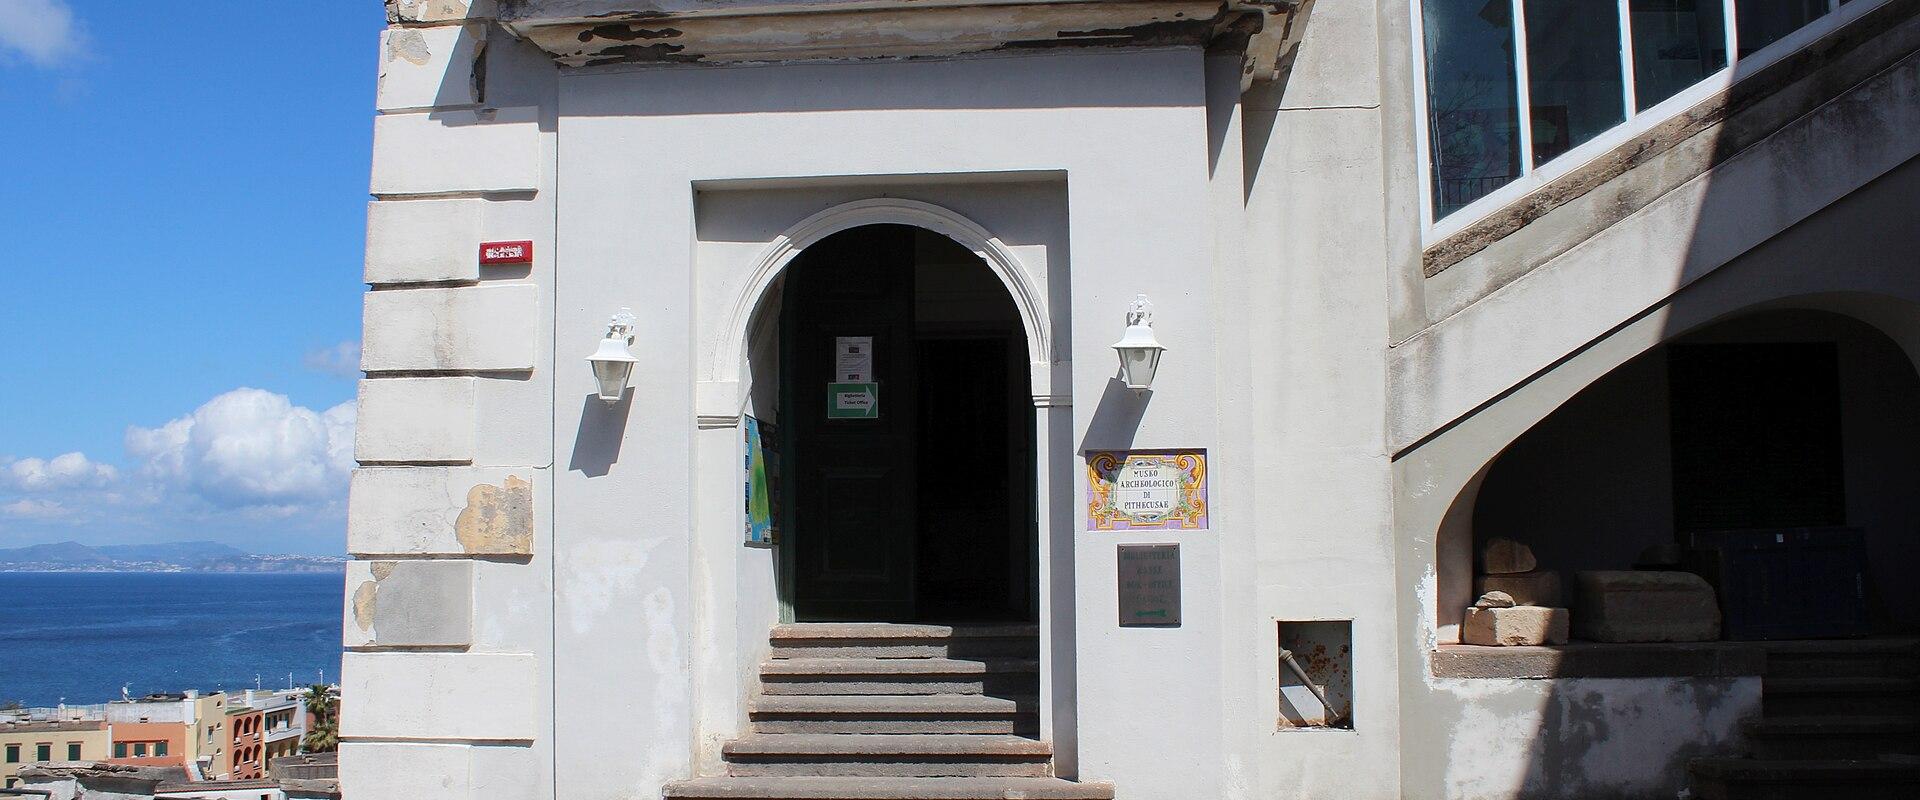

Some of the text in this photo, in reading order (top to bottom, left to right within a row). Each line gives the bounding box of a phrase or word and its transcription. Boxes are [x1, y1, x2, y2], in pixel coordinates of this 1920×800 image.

[1133, 470, 1158, 478] MUSEO
[1121, 480, 1174, 488] ARCHEOLOGICO
[1143, 491, 1151, 499] DI
[1124, 501, 1169, 509] PITHECUSAE
